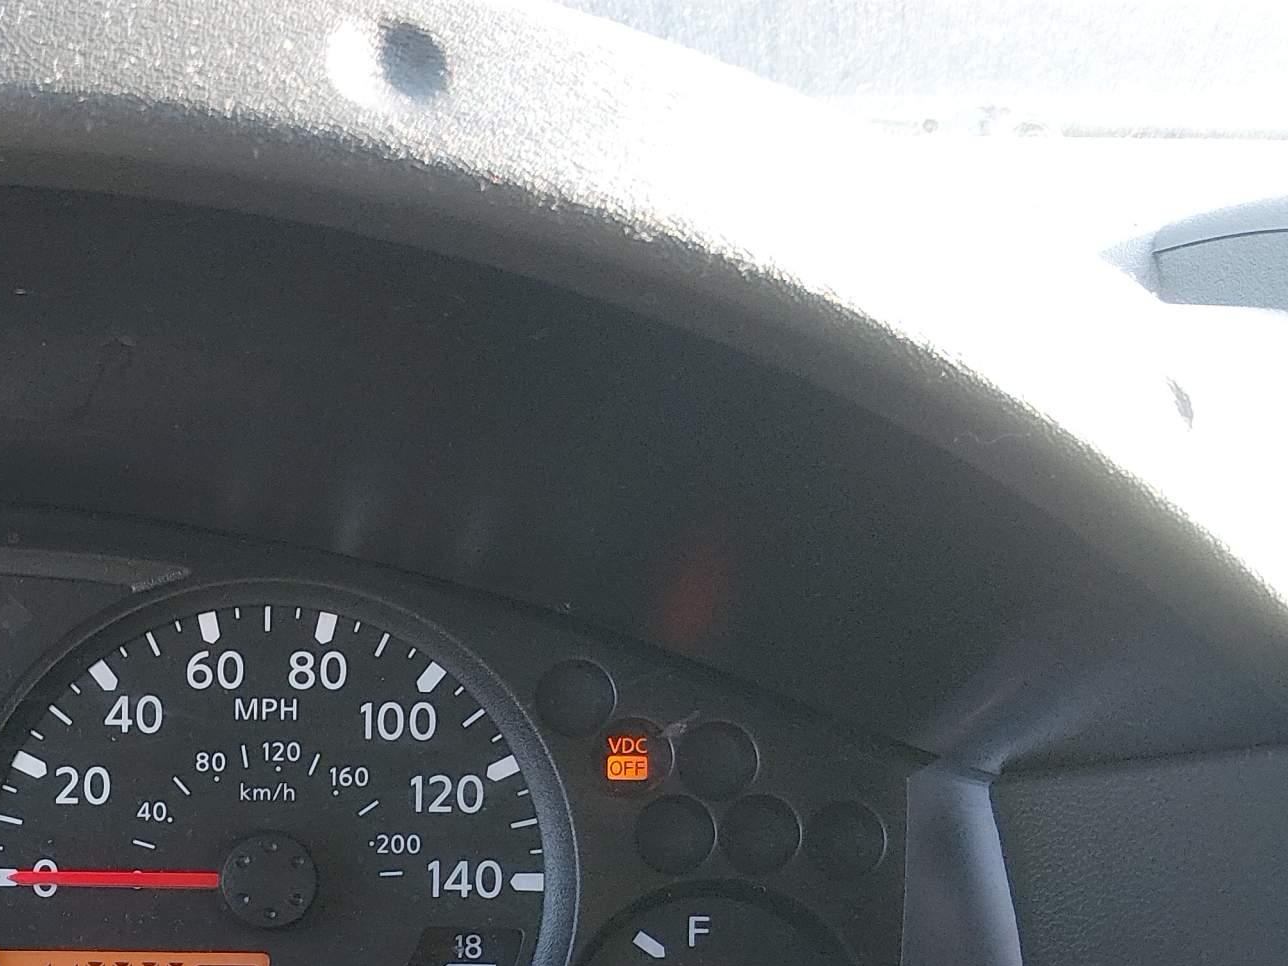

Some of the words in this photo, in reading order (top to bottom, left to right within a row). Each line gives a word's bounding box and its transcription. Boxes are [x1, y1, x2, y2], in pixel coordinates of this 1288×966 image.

[187, 651, 243, 690] 60
[288, 651, 346, 690] 80
[105, 695, 162, 734] 40
[235, 699, 298, 721] MPH
[361, 702, 436, 740] 100
[263, 742, 301, 762] 120
[608, 737, 648, 754] VDC
[195, 752, 226, 772] 80
[610, 760, 645, 776] OFF
[55, 766, 111, 806] 20
[329, 767, 369, 787] 160
[240, 783, 295, 801] km/h
[410, 775, 484, 813] 120
[137, 801, 167, 822] 40
[377, 835, 421, 854] 200
[33, 858, 58, 898] 0
[427, 860, 502, 899] 140
[688, 916, 710, 947] F
[455, 934, 482, 959] 18
